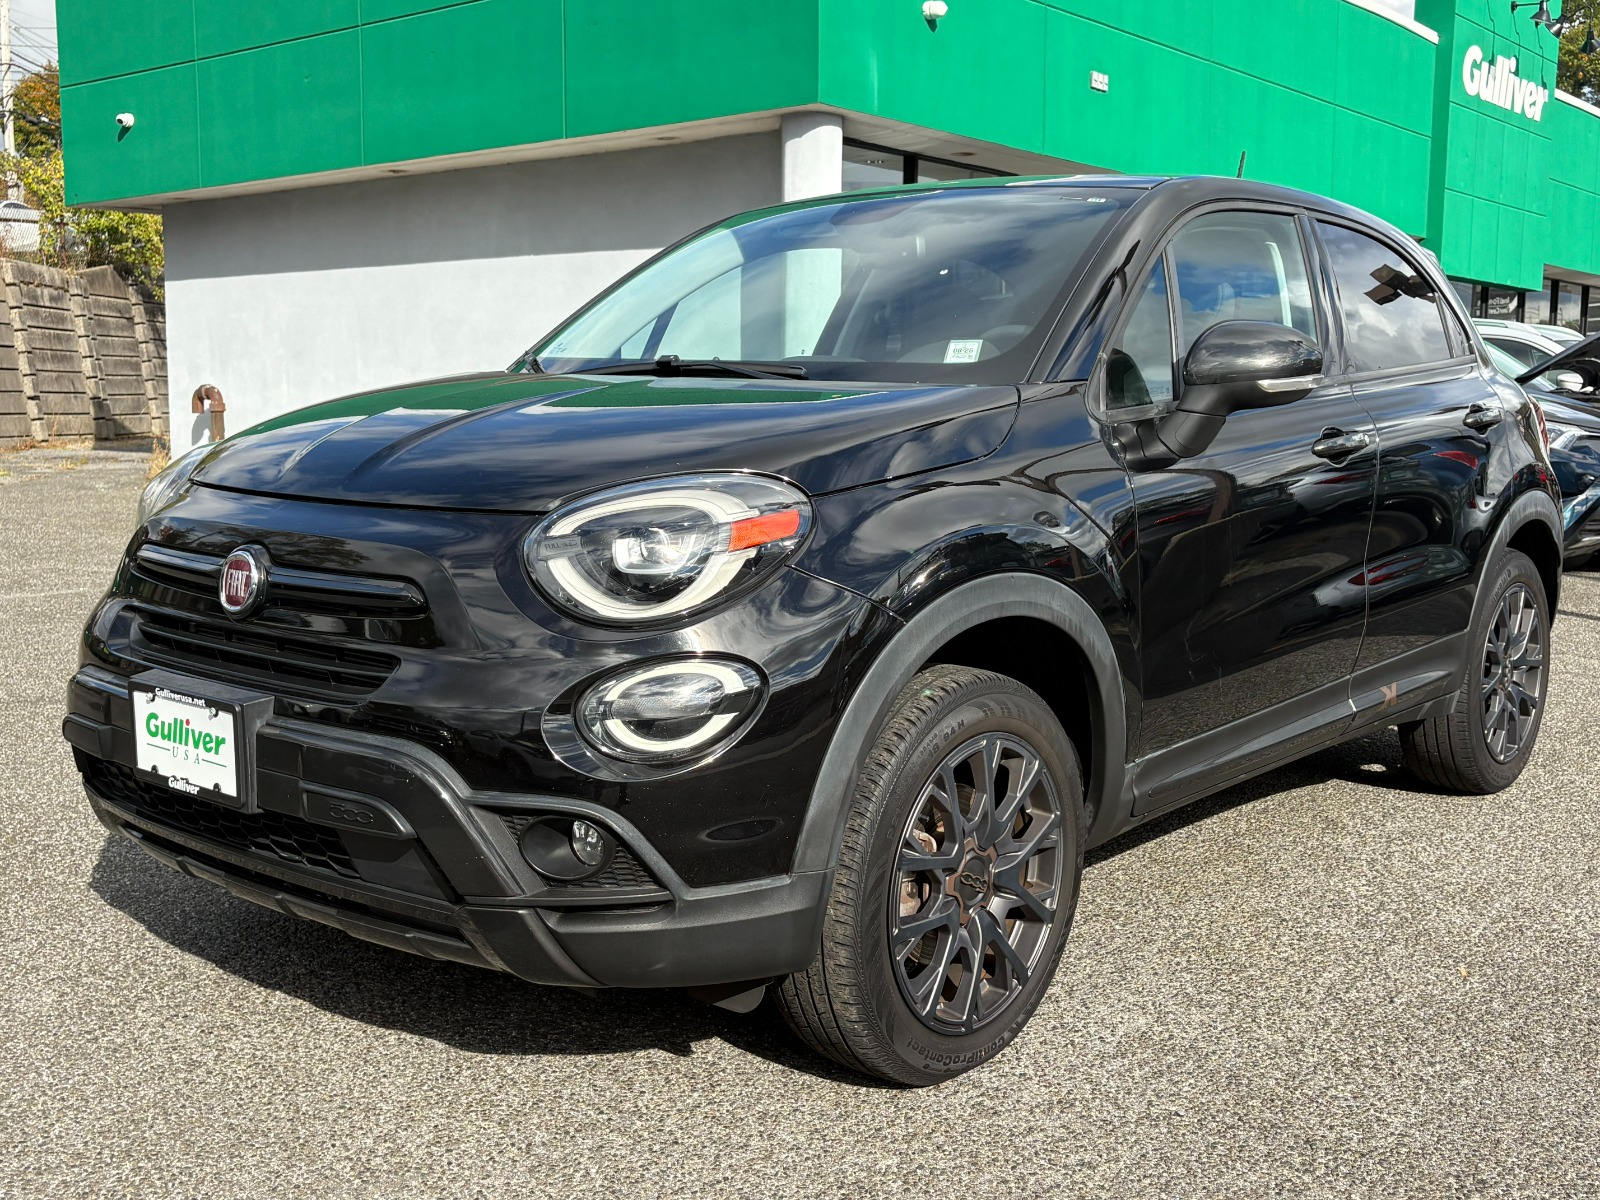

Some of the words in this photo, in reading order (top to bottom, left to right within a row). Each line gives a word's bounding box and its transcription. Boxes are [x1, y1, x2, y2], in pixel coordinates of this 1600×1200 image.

[1462, 44, 1548, 122] Gulliver
[226, 568, 249, 597] FIAT
[155, 687, 206, 706] Gulliverusa.net
[145, 712, 227, 756] Gulliver
[168, 776, 200, 795] Gulliver
[906, 1035, 1005, 1067] ContiProContact
